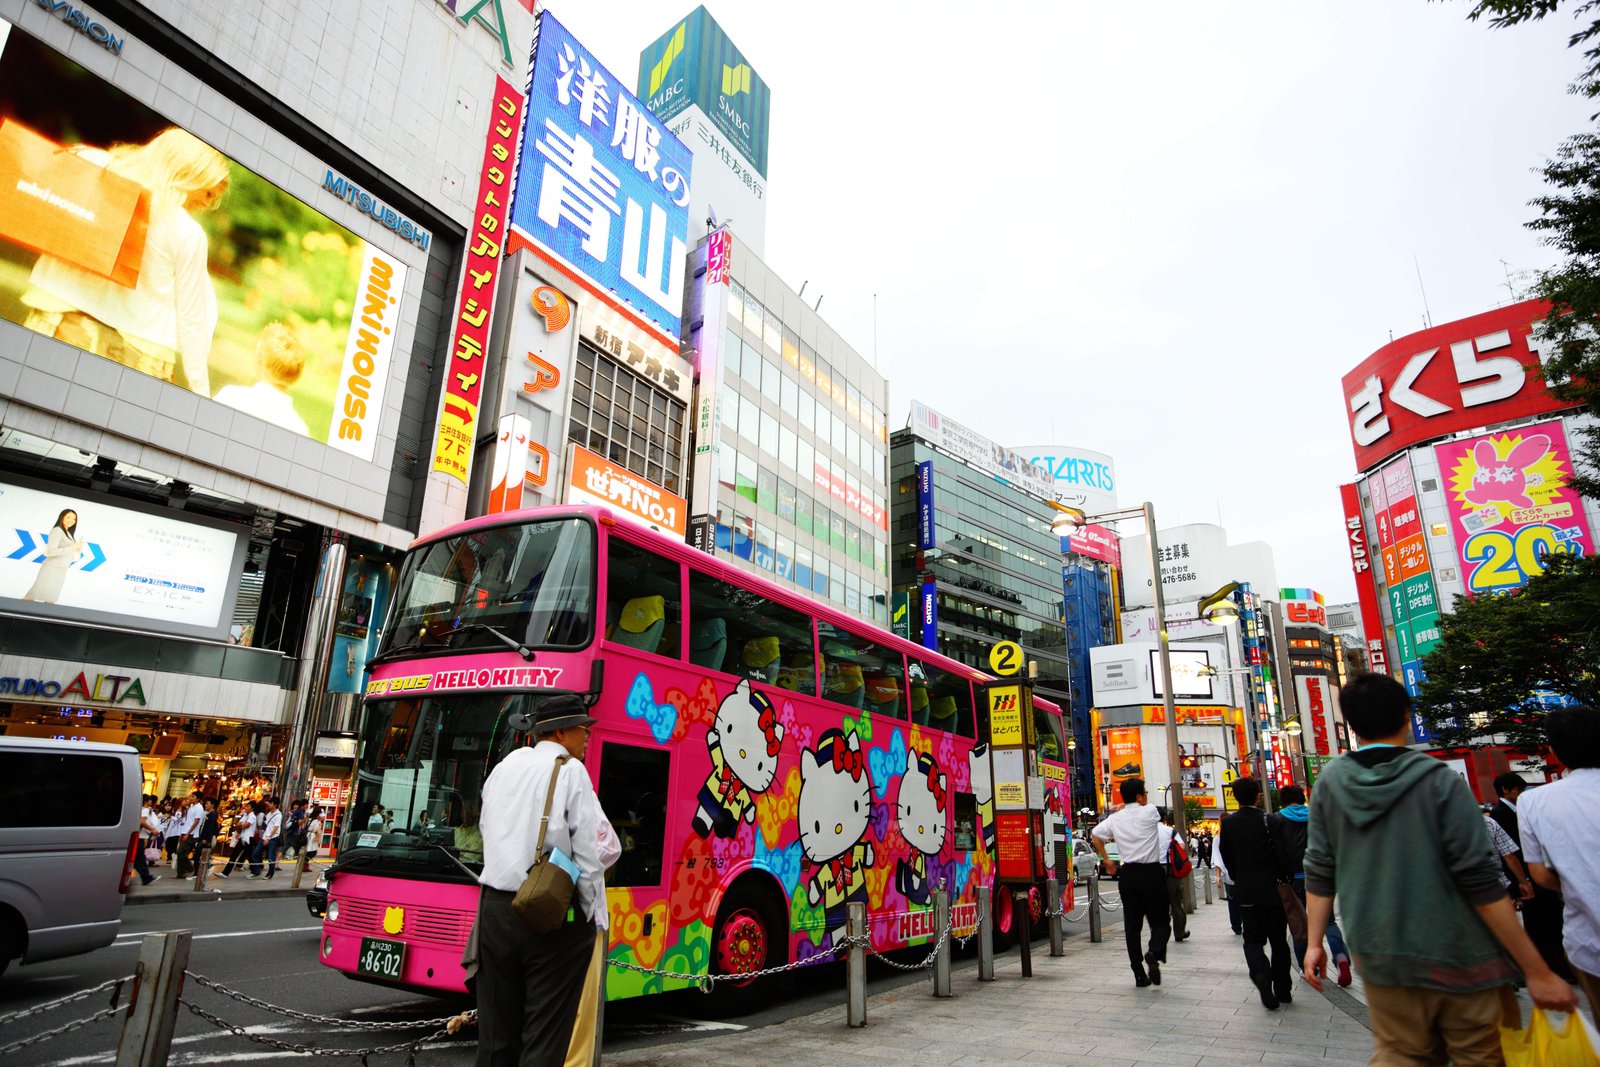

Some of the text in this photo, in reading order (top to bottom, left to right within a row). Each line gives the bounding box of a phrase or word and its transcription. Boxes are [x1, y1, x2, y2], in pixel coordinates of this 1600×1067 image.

[646, 78, 684, 112] SMBC
[554, 40, 691, 208] 洋服の
[719, 95, 750, 138] SMBC
[697, 121, 763, 200] 三井住友銀行
[324, 169, 432, 251] MITSUBISHI
[535, 117, 688, 321] 青山
[454, 96, 518, 393] コンタクトのアイシティ
[706, 232, 724, 285] リーブ21
[440, 424, 472, 446] 三井住友銀行
[444, 437, 466, 456] 7F
[435, 455, 467, 475] 年中無休
[585, 466, 676, 528] 世界No.1
[1514, 507, 1543, 517] さくらや
[1515, 509, 1570, 523] ポイントカードで
[1380, 516, 1388, 543] 4F
[1555, 528, 1581, 541] 最大
[1347, 515, 1369, 574] さくらや
[1399, 541, 1423, 559] デジタル
[1386, 553, 1395, 581] 3F
[1406, 580, 1430, 597] デジカメ
[1409, 593, 1433, 610] DPE受付
[1287, 602, 1326, 627] ビック
[1393, 591, 1402, 619] 2F
[996, 644, 1015, 670] 2
[1400, 629, 1409, 658] 1F
[0, 671, 147, 705] STUDIO ALTA
[390, 674, 433, 692] BUS
[434, 669, 490, 689] HELLO
[491, 667, 562, 688] KITTY
[1102, 680, 1129, 688] SoftBank
[1406, 668, 1416, 697] B1
[992, 725, 1020, 735] はとバス
[1306, 677, 1330, 756] ビックカメラ
[1045, 764, 1066, 782] BUS
[1225, 771, 1232, 781] 1
